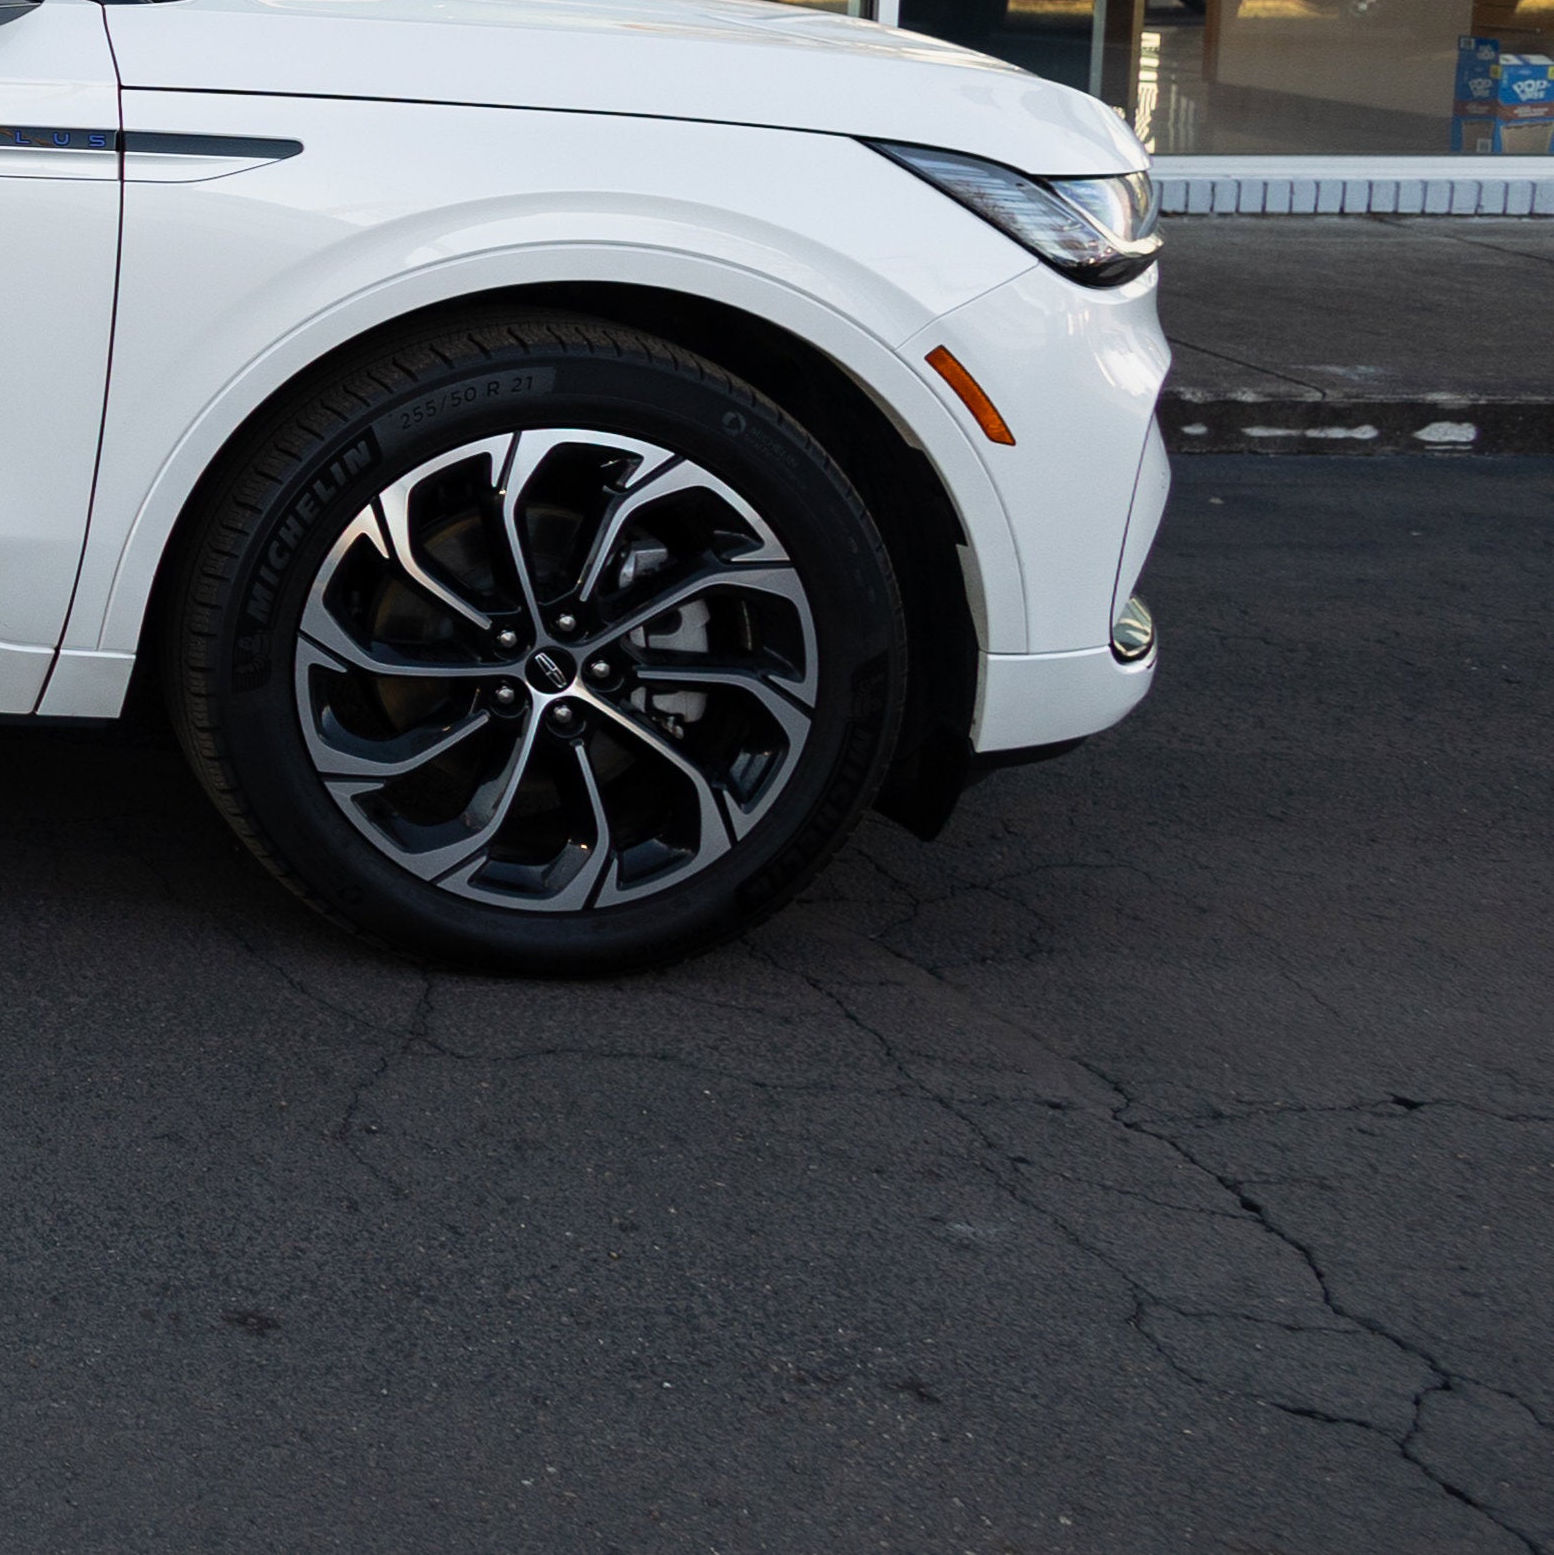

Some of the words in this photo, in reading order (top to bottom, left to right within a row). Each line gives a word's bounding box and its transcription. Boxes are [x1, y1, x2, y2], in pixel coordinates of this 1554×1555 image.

[400, 386, 478, 431] 255/50
[486, 382, 501, 397] R
[510, 375, 534, 393] 21
[246, 438, 374, 624] MICHELIN
